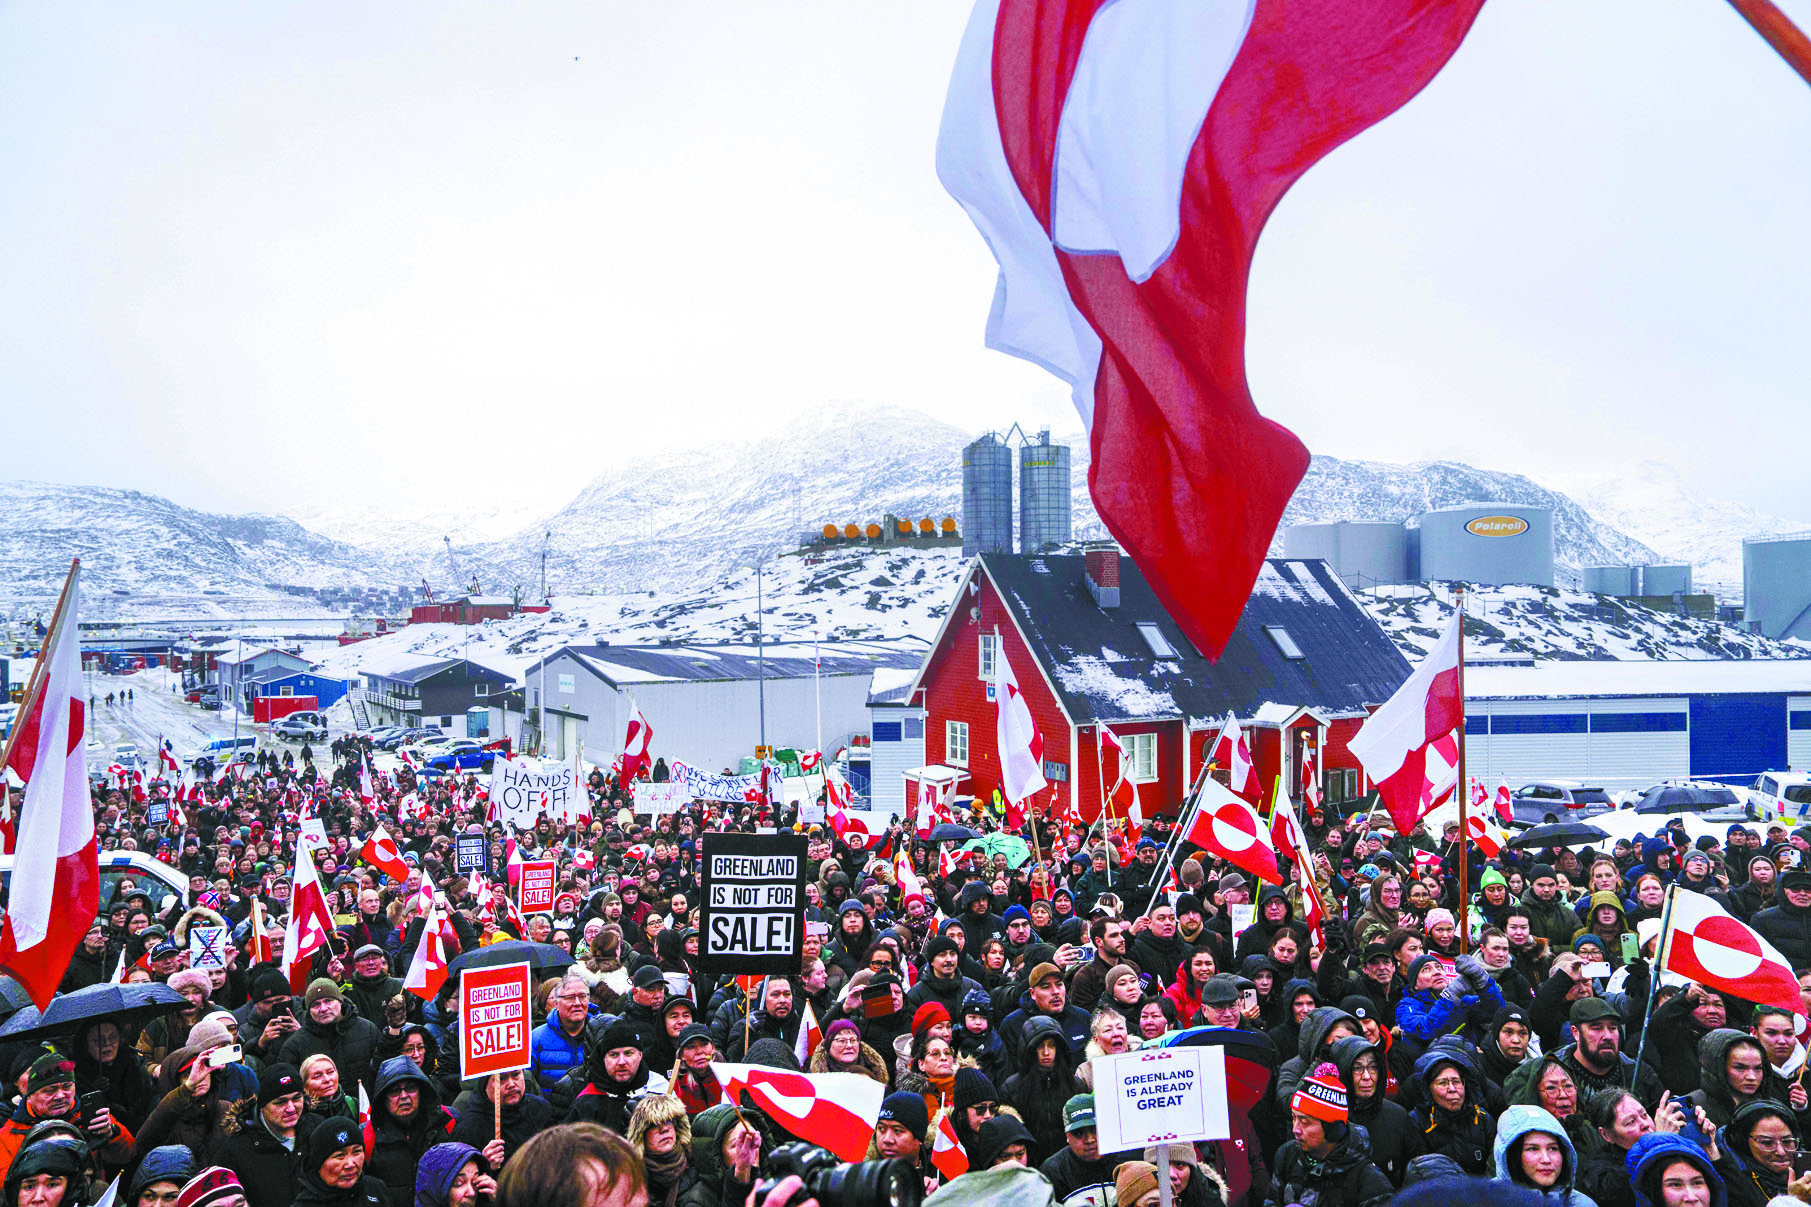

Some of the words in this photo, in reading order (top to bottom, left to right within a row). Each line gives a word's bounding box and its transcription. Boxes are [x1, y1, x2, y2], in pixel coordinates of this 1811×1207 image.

[1474, 521, 1522, 531] Polaroil
[504, 768, 571, 787] HANDS
[686, 776, 744, 801] FUTURE
[460, 855, 482, 866] SALE!
[714, 857, 795, 876] GREENLAND
[525, 890, 550, 904] SALE!
[712, 887, 726, 905] IS
[732, 888, 760, 905] NOT
[767, 887, 793, 905] FOR
[711, 916, 792, 952] SALE!
[471, 984, 521, 1003] GREENLAND
[472, 1009, 480, 1023] IS
[484, 1006, 501, 1021] NOT
[505, 1003, 521, 1017] FOR
[473, 1023, 521, 1056] SALE!
[1124, 1069, 1194, 1085] GREENLAND
[1126, 1088, 1137, 1098] IS
[1140, 1081, 1193, 1096] ALREADY
[1137, 1095, 1184, 1110] GREAT
